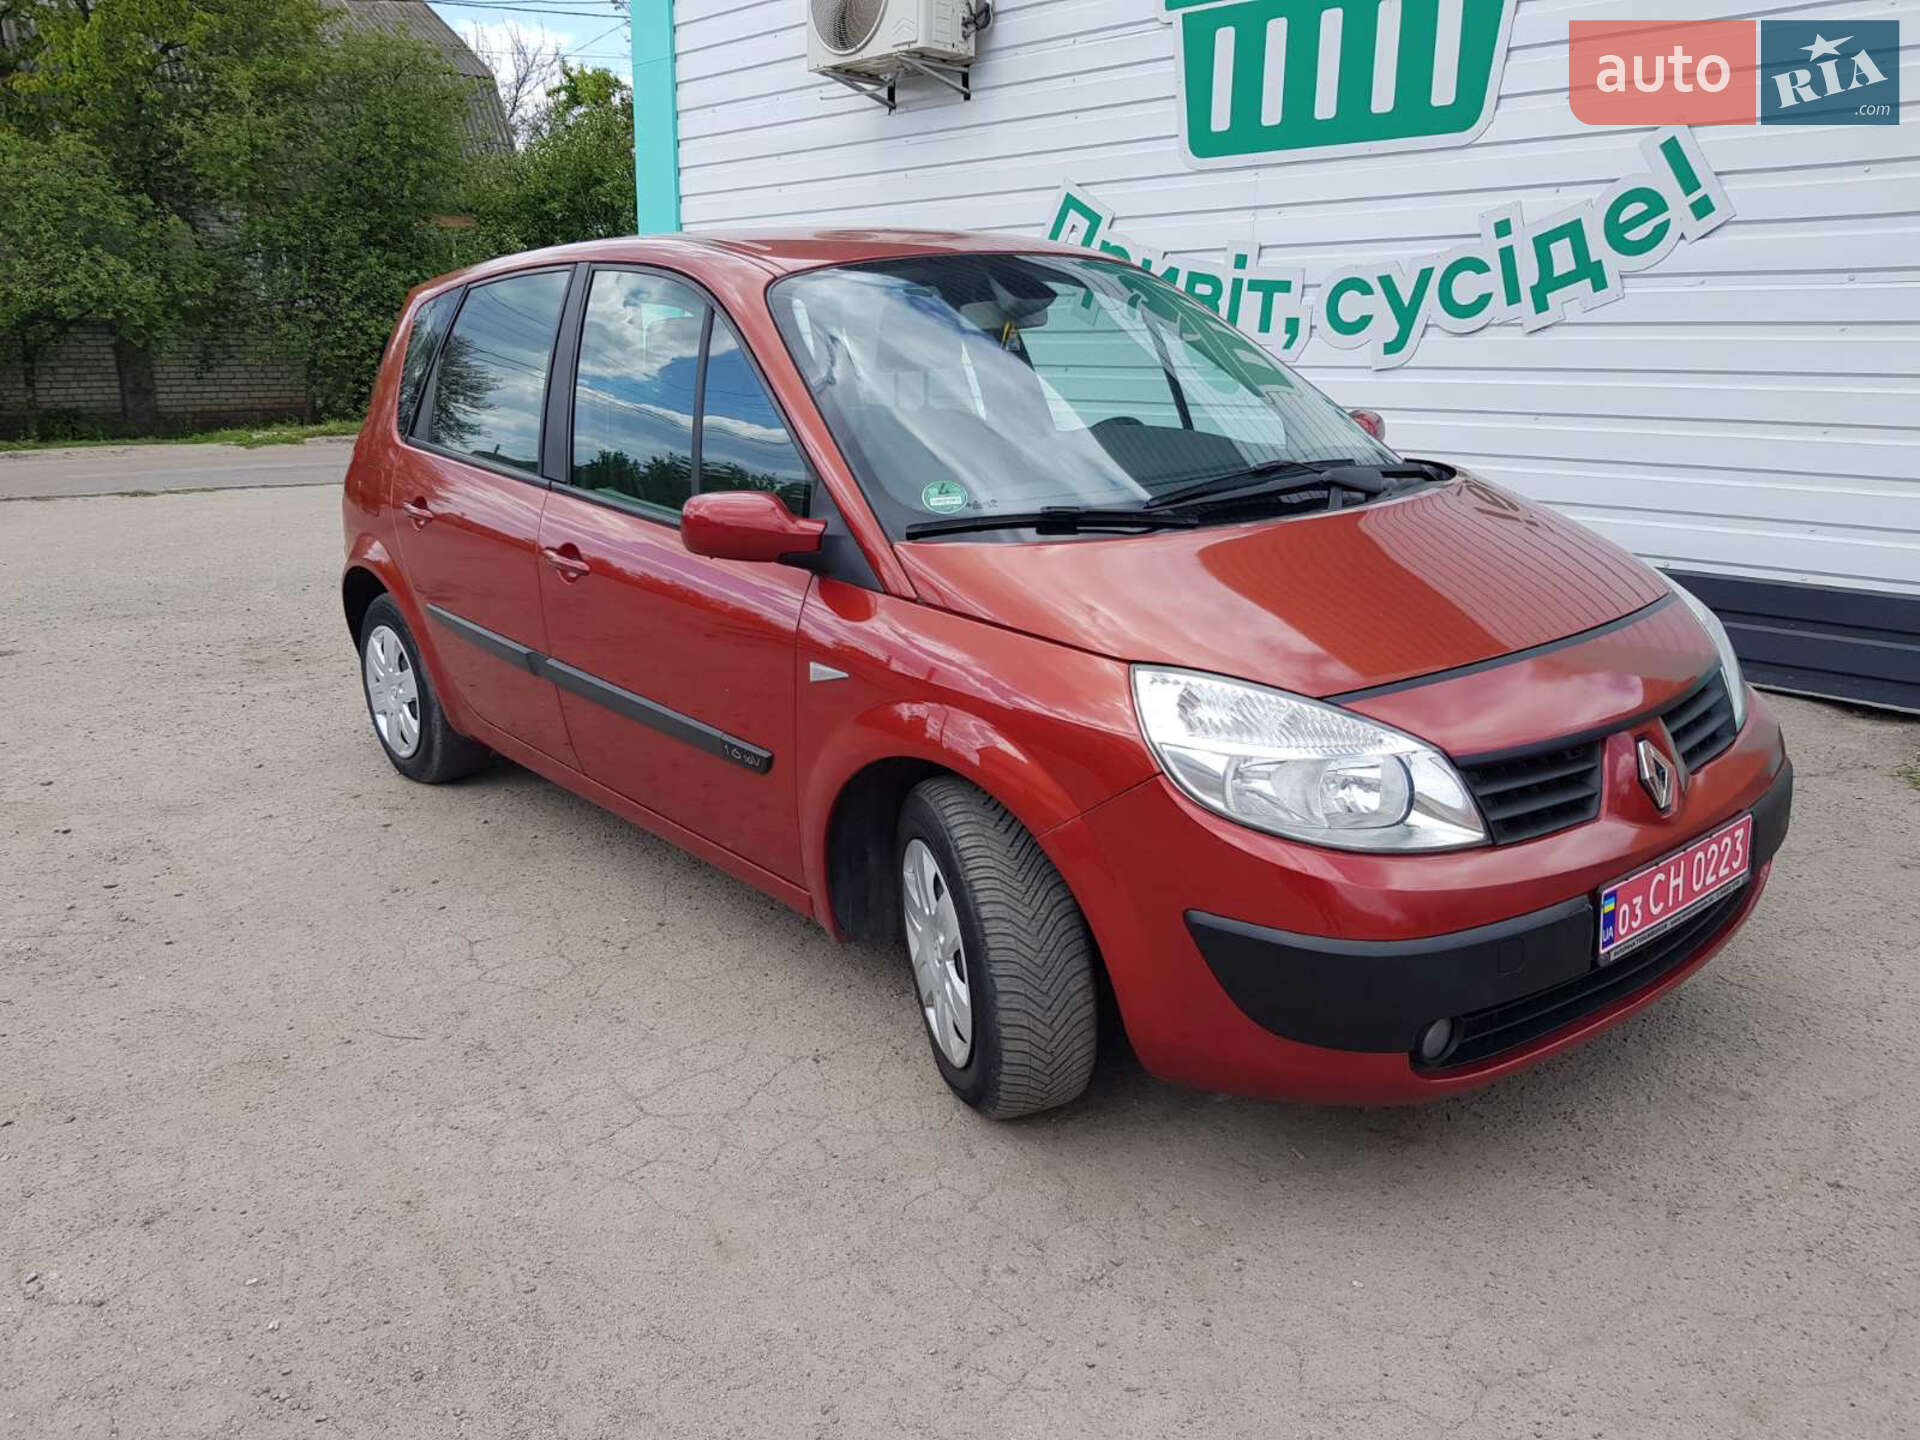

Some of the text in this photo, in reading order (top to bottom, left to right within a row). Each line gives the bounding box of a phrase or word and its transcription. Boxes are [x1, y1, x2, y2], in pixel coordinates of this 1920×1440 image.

[1326, 135, 1716, 355] сусіде!
[1602, 925, 1614, 942] UA
[1618, 896, 1643, 936] 03
[1649, 860, 1685, 915] CH
[1692, 827, 1744, 892] 0223
